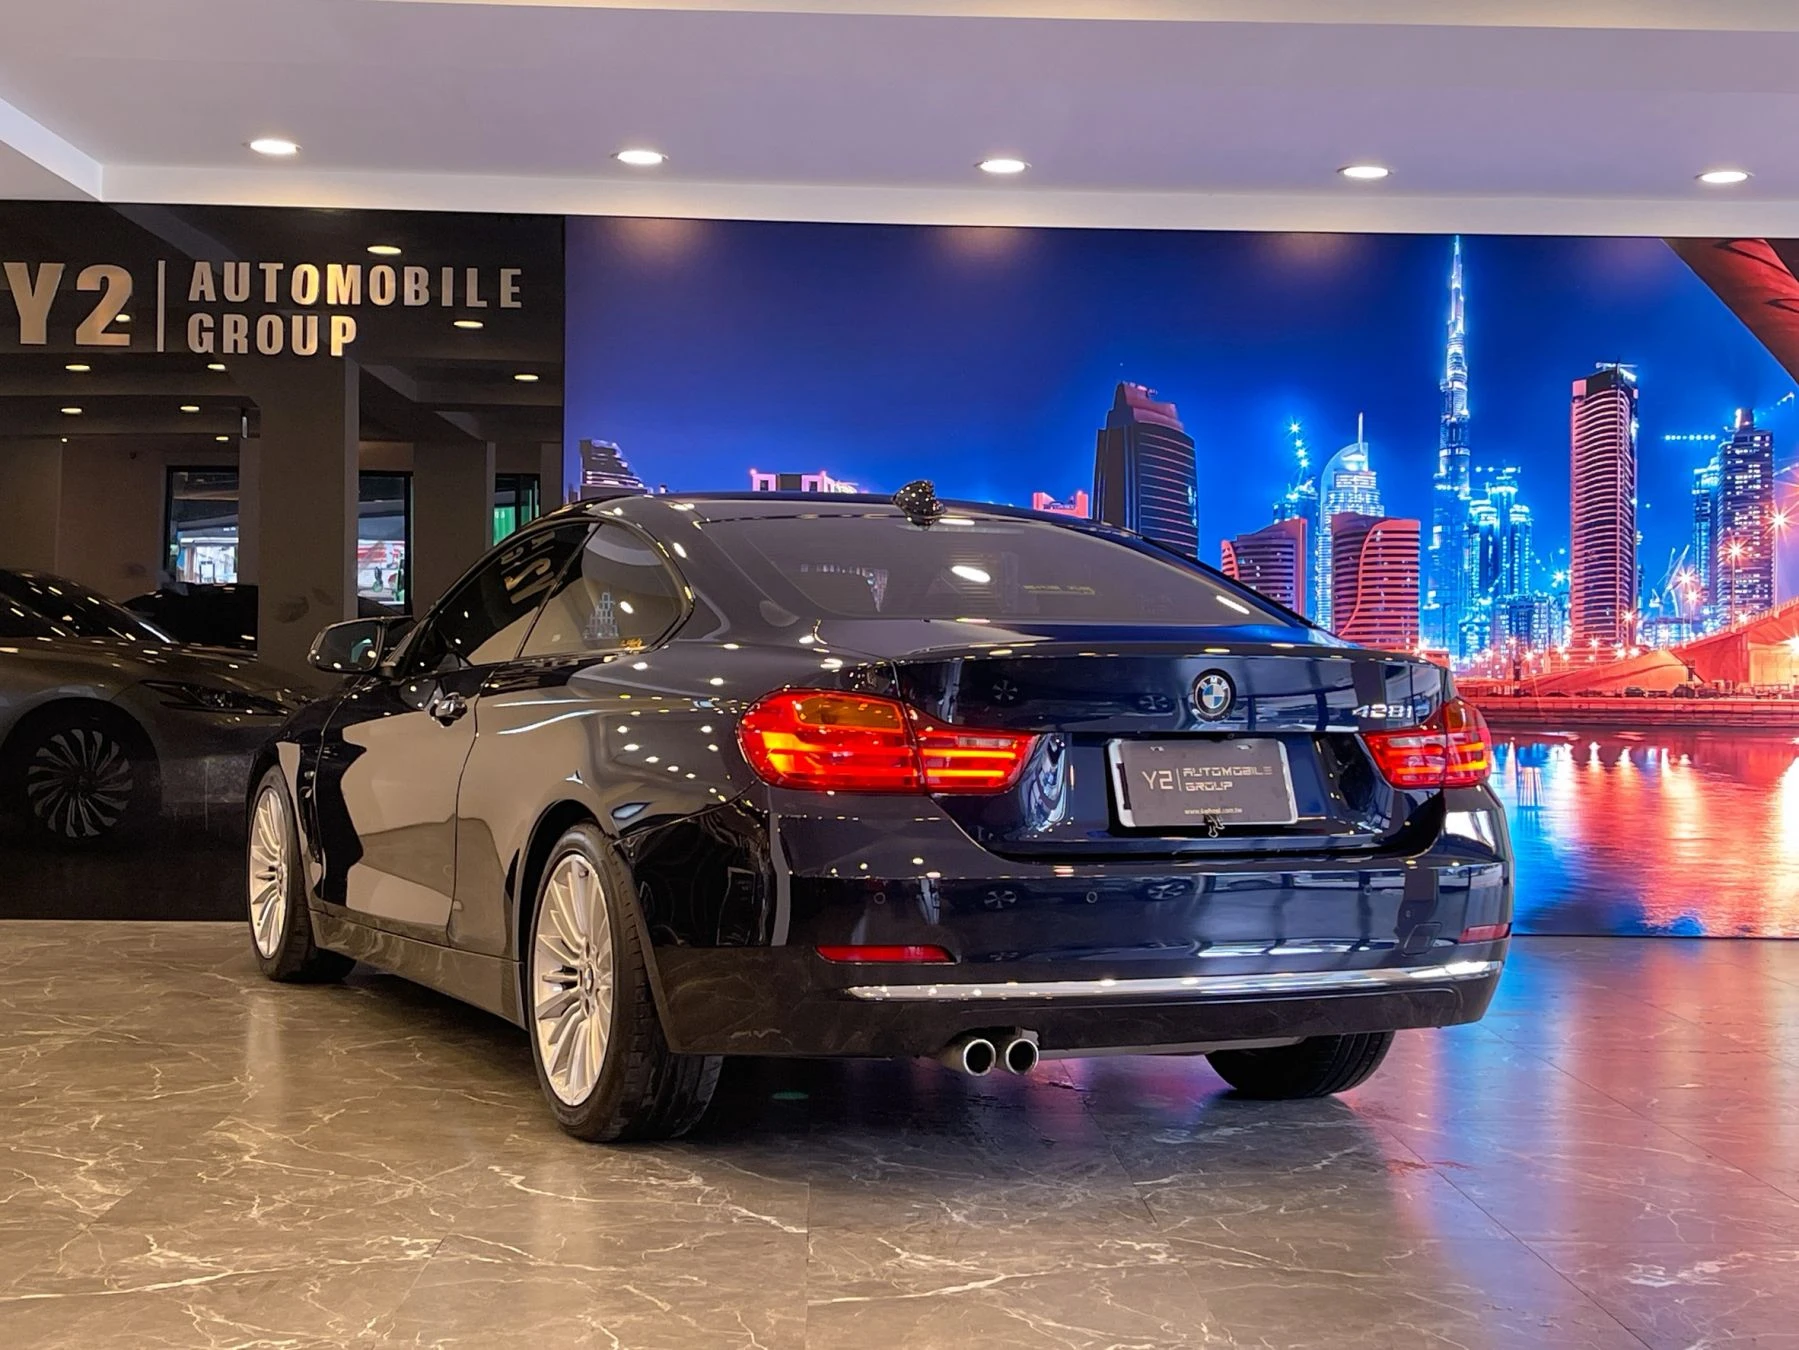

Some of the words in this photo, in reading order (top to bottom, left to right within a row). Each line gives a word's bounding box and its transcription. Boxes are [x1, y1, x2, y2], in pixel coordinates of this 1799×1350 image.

[187, 261, 523, 308] AUTOMOBILE
[2, 261, 134, 346] Y2
[187, 312, 358, 356] GROUP
[1142, 770, 1175, 790] Y2
[1183, 766, 1273, 777] AUTOMOBILE
[1185, 781, 1233, 792] GROUP
